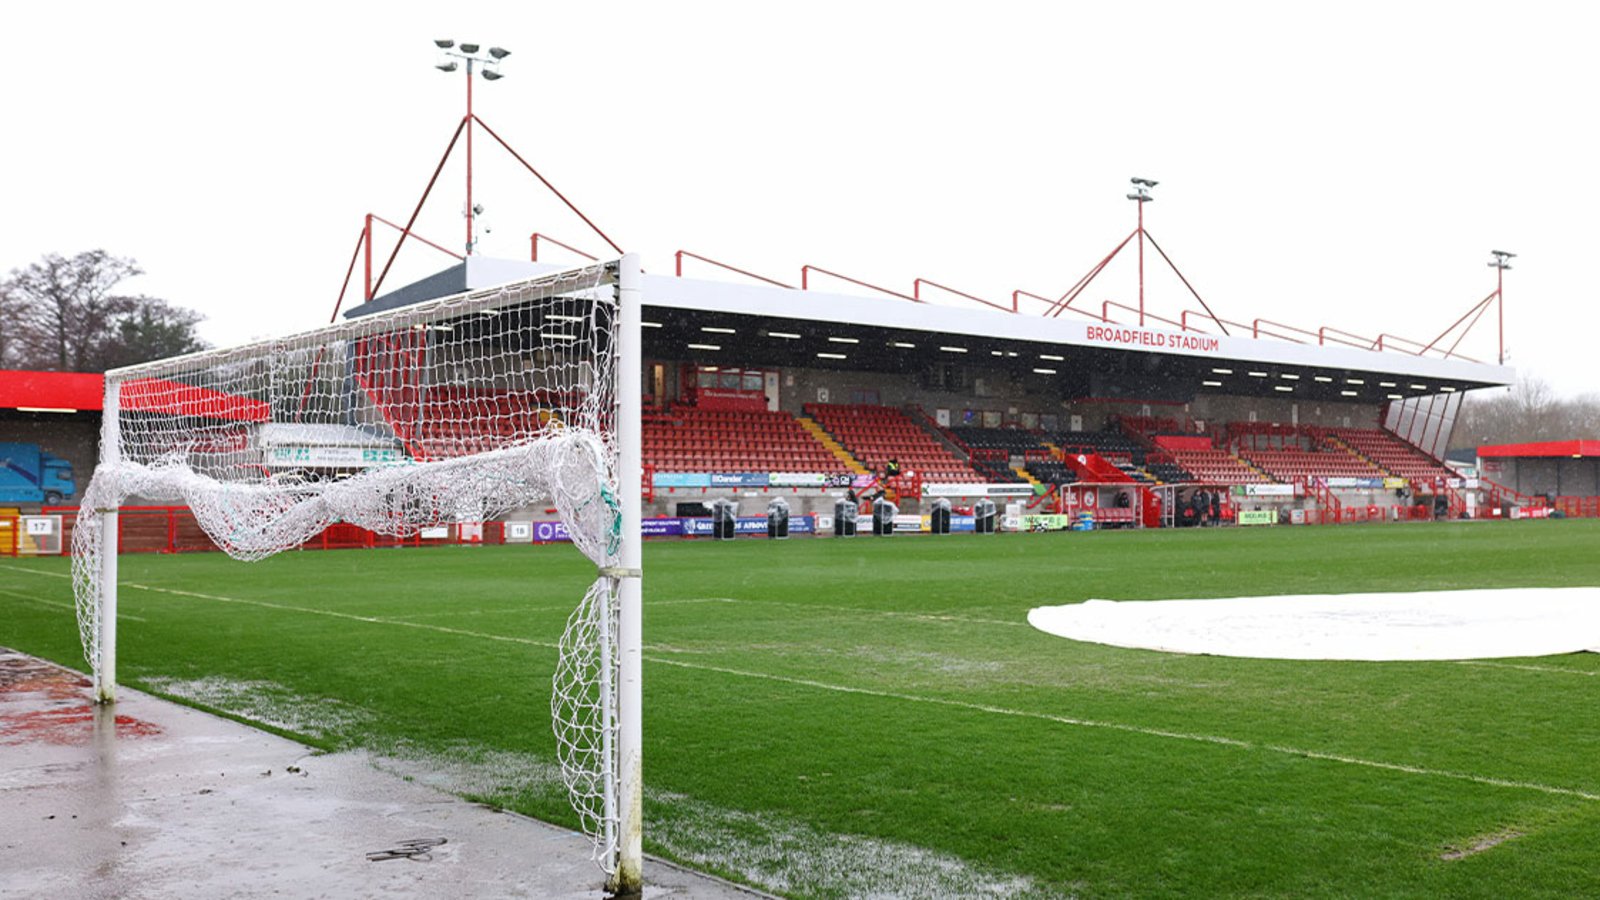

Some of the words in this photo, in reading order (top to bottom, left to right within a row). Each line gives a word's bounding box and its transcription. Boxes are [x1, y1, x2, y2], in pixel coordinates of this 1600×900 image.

[1087, 325, 1165, 346] BROADFIELD
[1168, 335, 1219, 352] STADIUM
[33, 523, 46, 531] 17
